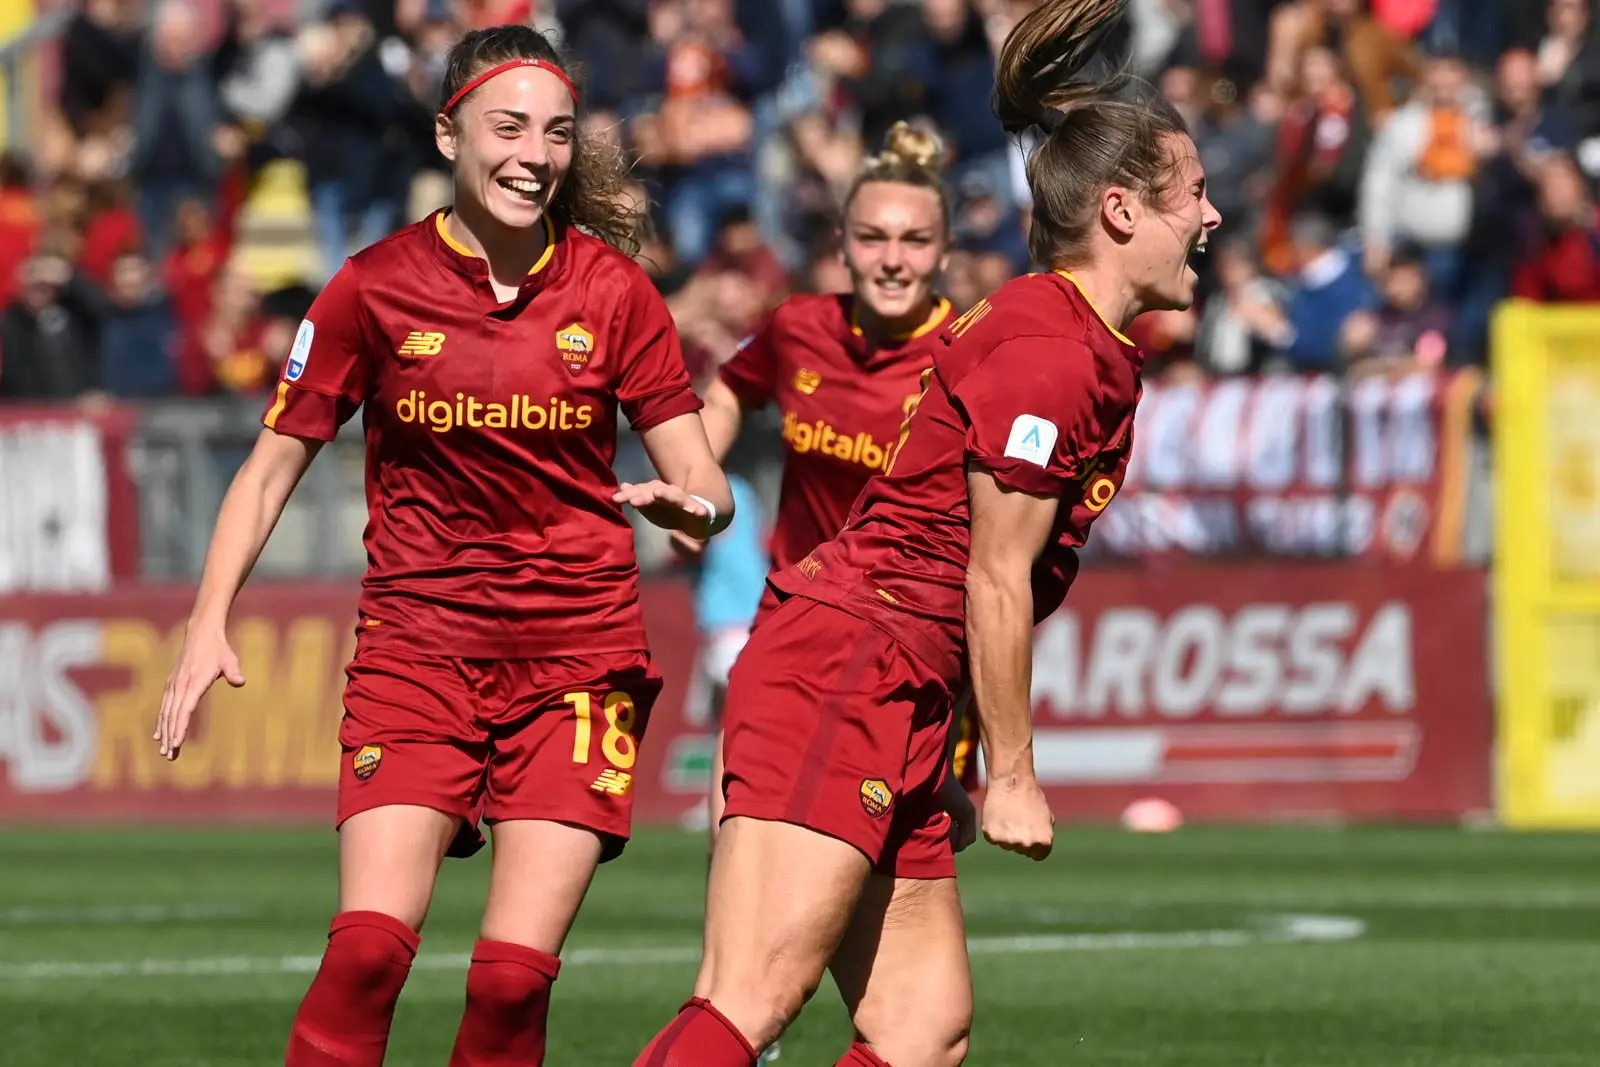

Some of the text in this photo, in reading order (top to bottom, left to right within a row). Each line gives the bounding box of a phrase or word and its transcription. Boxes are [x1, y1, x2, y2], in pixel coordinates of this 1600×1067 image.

[562, 352, 588, 363] ROMA
[396, 389, 593, 433] digitalbits
[563, 691, 636, 769] 18
[862, 796, 883, 814] ROMA
